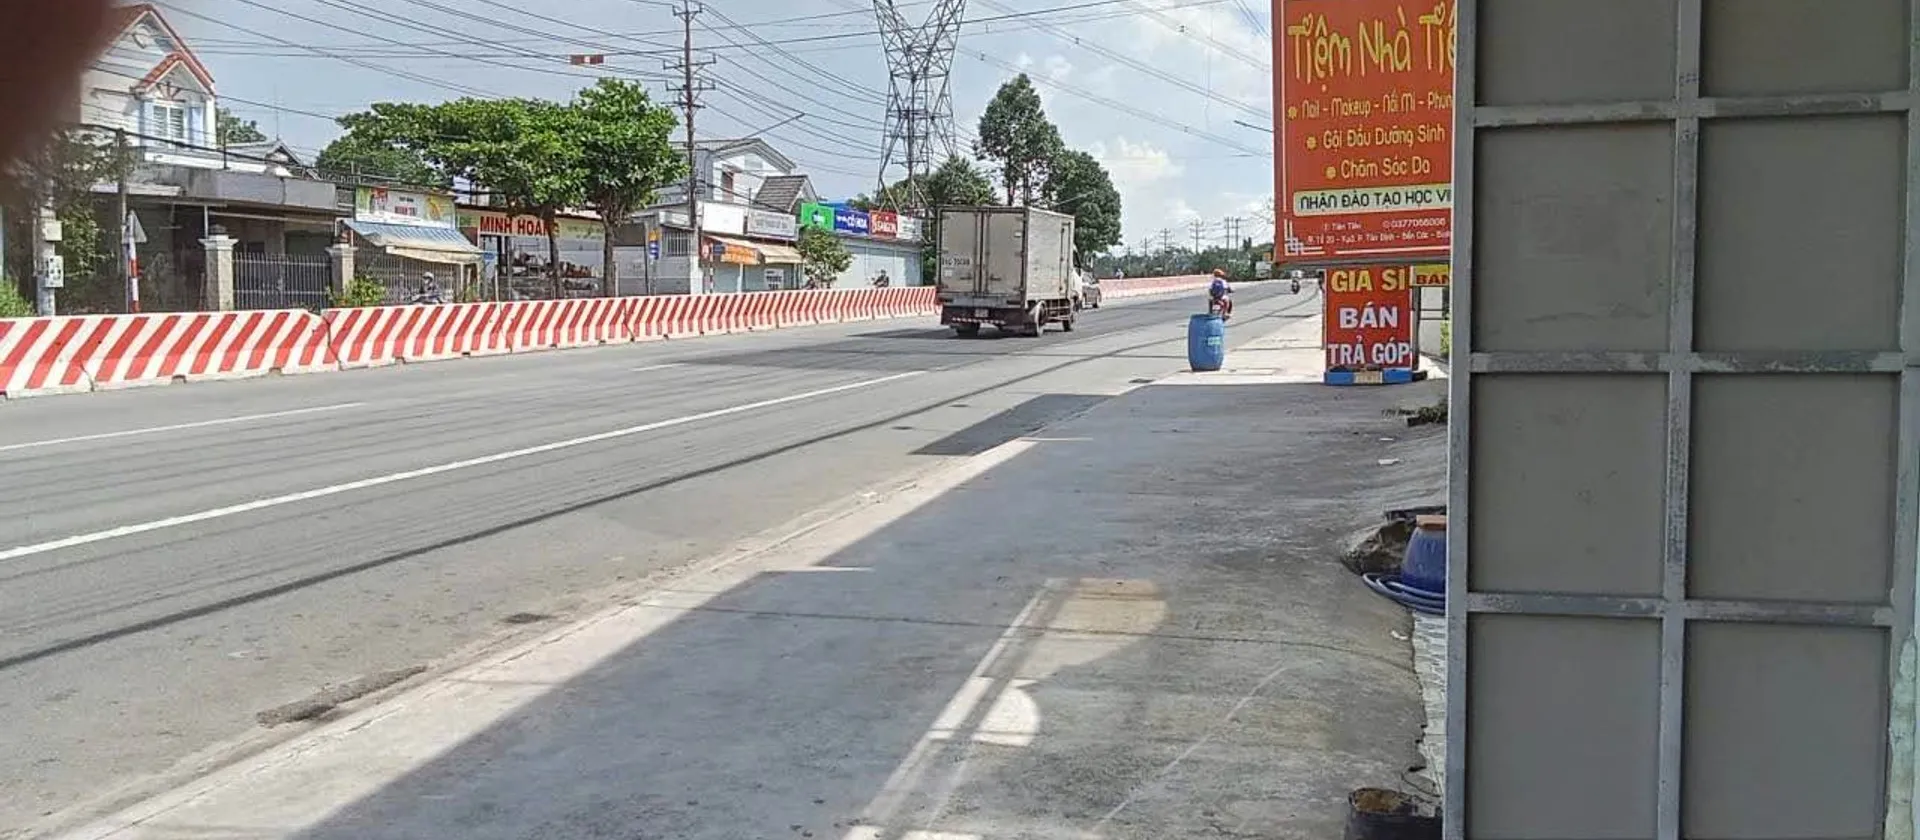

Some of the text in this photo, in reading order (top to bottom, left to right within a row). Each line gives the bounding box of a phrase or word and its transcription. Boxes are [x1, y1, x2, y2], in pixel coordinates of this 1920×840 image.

[1287, 13, 1351, 92] Tiệm
[1358, 5, 1412, 77] Nhà
[1331, 97, 1371, 118] Makeup
[1417, 123, 1445, 143] Sinh
[1382, 155, 1408, 177] Sóc
[1412, 156, 1431, 175] Da
[1341, 189, 1370, 208] ĐÀO
[1373, 190, 1401, 210] TẠO
[1404, 189, 1433, 208] HỌC
[480, 215, 513, 234] MINH
[1339, 301, 1398, 329] BÁN
[1328, 335, 1411, 365] TRẢ GÓP
